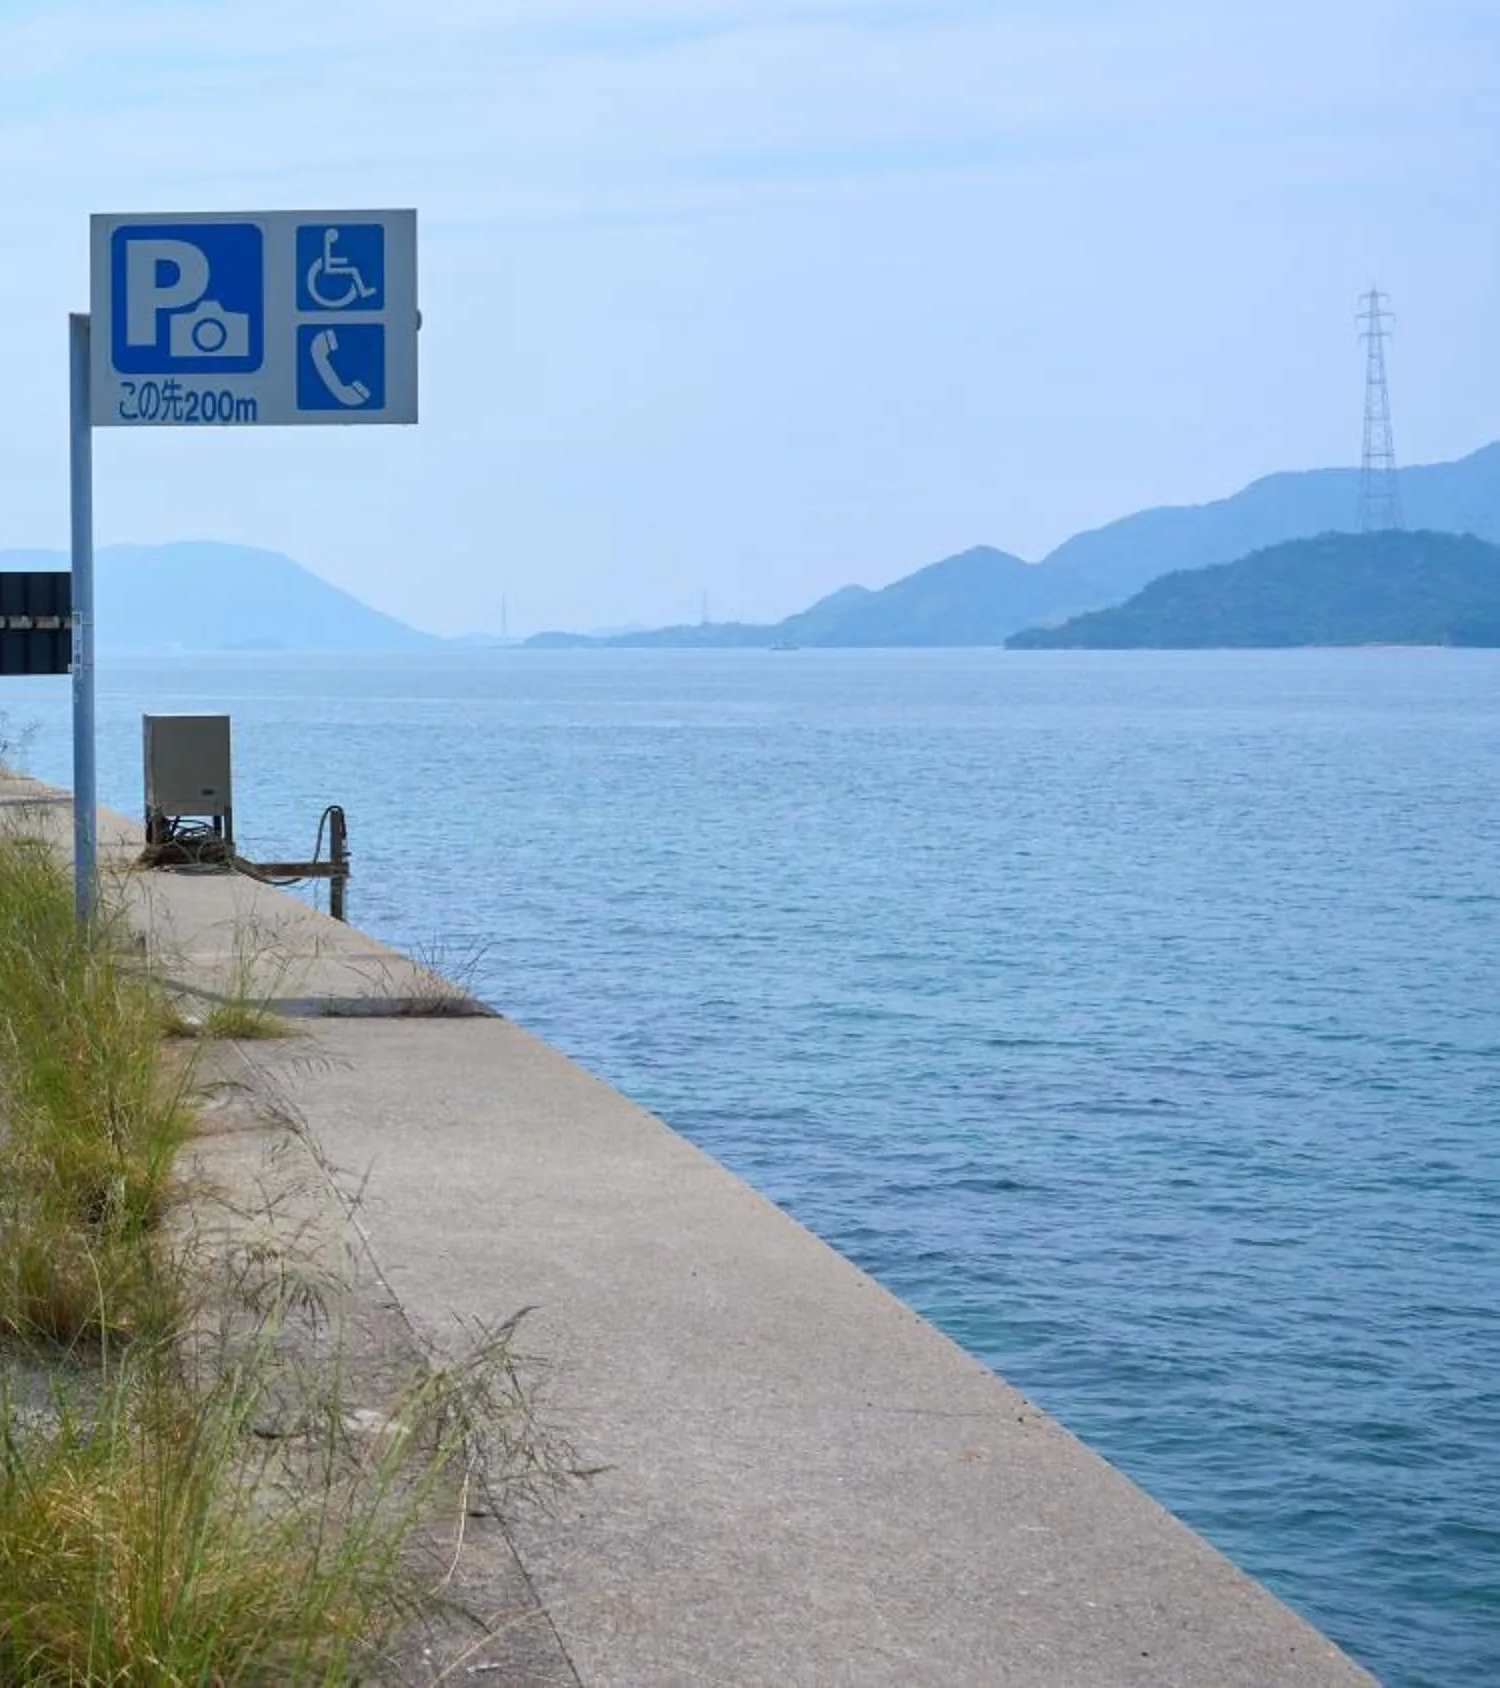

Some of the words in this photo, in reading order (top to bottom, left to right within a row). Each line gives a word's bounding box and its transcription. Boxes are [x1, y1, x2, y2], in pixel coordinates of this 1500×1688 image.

[127, 239, 210, 346] P
[119, 378, 257, 422] この先200m
